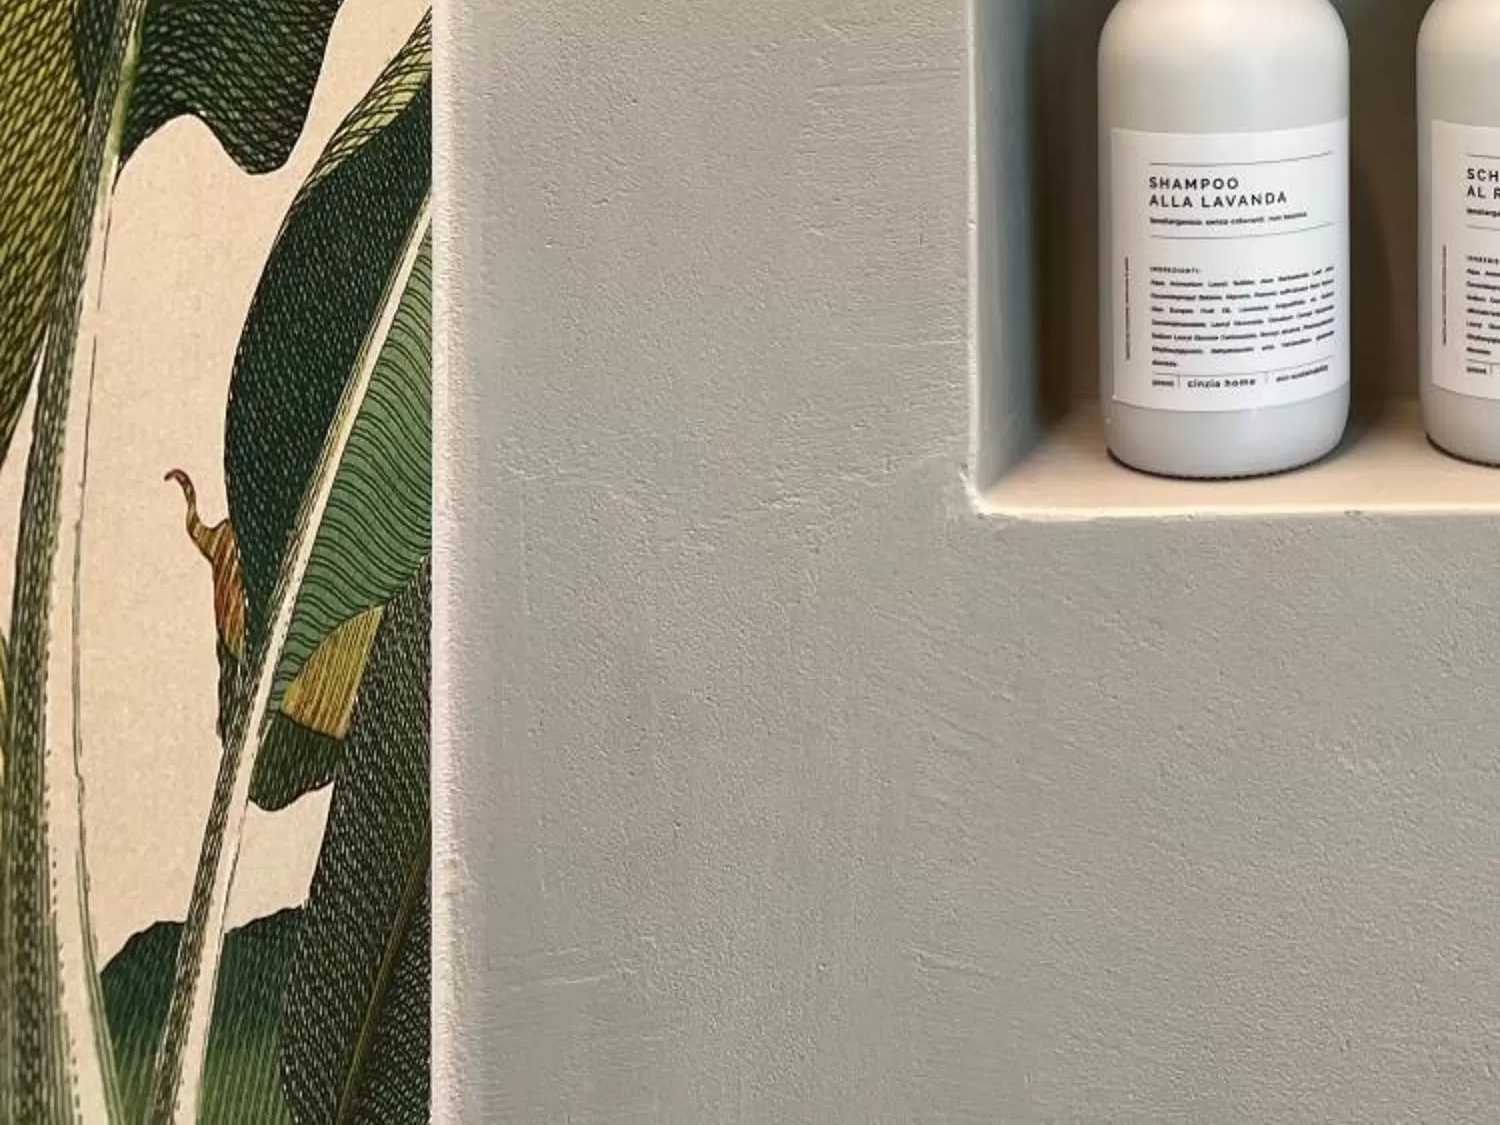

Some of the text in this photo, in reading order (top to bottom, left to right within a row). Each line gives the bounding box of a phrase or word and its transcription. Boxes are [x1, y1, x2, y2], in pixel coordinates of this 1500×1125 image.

[1148, 176, 1239, 190] SHAMPOO
[1466, 184, 1486, 199] AL
[1148, 191, 1287, 208] ALLA LAVANDA
